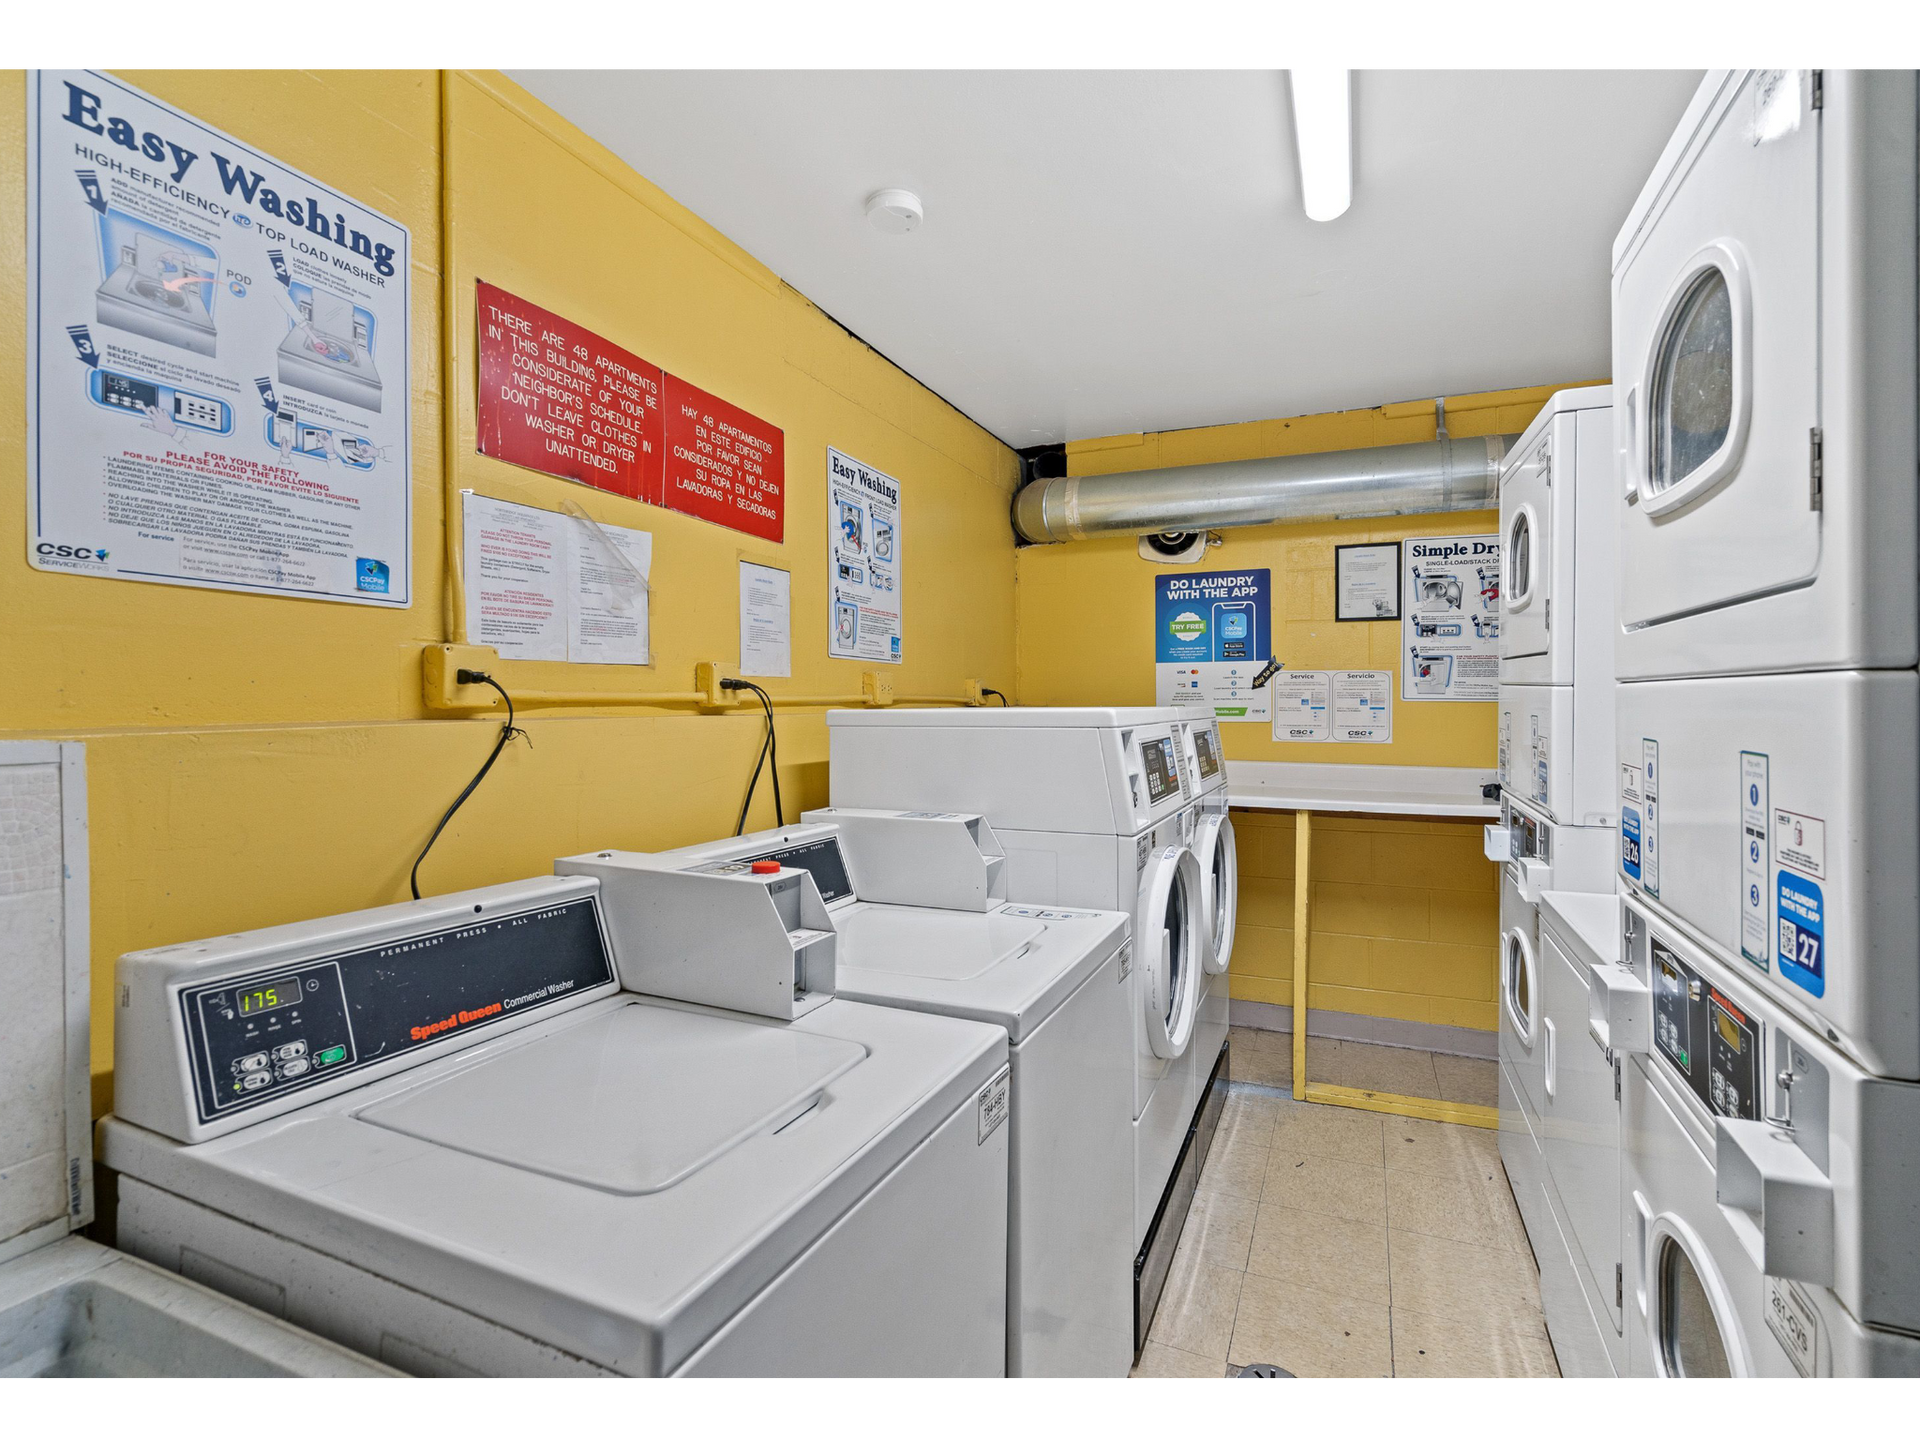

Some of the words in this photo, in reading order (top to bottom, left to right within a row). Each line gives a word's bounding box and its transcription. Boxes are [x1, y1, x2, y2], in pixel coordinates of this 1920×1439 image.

[62, 80, 198, 184] Easy
[211, 151, 395, 277] Washing
[75, 143, 230, 219] HIGH-EFFICIENCY
[86, 184, 98, 199] 1
[256, 222, 286, 242] TOP
[290, 238, 328, 262] LOAD
[332, 256, 385, 288] WASHER
[275, 262, 286, 275] 2
[293, 257, 310, 267] LOAD
[226, 269, 252, 286] POD
[78, 339, 93, 354] 3
[488, 305, 532, 336] THERE
[541, 330, 565, 351] ARE
[573, 345, 588, 361] 48
[595, 355, 657, 394] APARTMENTS
[107, 344, 138, 357] SELECT
[140, 353, 166, 365] desired
[167, 360, 184, 371] cycle
[185, 365, 198, 374] and
[199, 369, 213, 379] start
[214, 373, 240, 387] machine
[488, 324, 501, 341] IN
[510, 332, 539, 356] THIS
[603, 374, 641, 402] PLEASE
[645, 394, 657, 410] BE
[263, 390, 274, 402] 4
[512, 353, 592, 397] CONSIDERATE
[599, 389, 613, 404] OF
[619, 397, 645, 419] YOUR
[513, 371, 583, 410] NEIGHBOR'S
[590, 402, 643, 434] SCHEDULE.
[501, 385, 540, 411] DON'T
[547, 403, 584, 428] LEAVE
[591, 420, 637, 448] CLOTHES
[642, 440, 652, 453] IN
[681, 404, 698, 420] HAY
[703, 415, 714, 427] 48
[718, 422, 773, 454] APARTAMENTOS
[525, 412, 575, 441] WASHER
[581, 433, 596, 449] OR
[603, 441, 635, 463] DRYER
[695, 425, 706, 438] EN
[711, 431, 731, 449] ESTE
[735, 442, 762, 462] EDIFICIO
[107, 462, 150, 475] FLAMMABLE
[152, 471, 189, 483] MATERIALS
[166, 451, 210, 466] PLEASE
[213, 461, 247, 474] AVOID
[251, 468, 271, 479] THE
[274, 474, 329, 491] FOLLOWING
[204, 451, 226, 462] FOR
[230, 457, 258, 469] YOUR
[261, 464, 299, 478] SAFETY
[546, 438, 619, 474] UNATTENDED.
[673, 445, 733, 477] CONSIDERADOS
[737, 469, 743, 480] Y
[746, 474, 756, 486] NO
[759, 479, 779, 495] DEJEN
[696, 440, 713, 455] POR
[716, 448, 740, 466] FAVOR
[744, 460, 762, 475] SEAN
[123, 450, 143, 459] POR
[145, 455, 158, 463] SU
[160, 458, 193, 470] PROPIA
[195, 466, 245, 481] SEGURIDAD,
[246, 476, 263, 485] POR
[264, 479, 289, 489] FAVOR
[291, 484, 312, 494] EVITE
[313, 488, 322, 496] LO
[324, 490, 359, 504] SIGUIENTE
[695, 468, 707, 481] SU
[711, 474, 731, 490] ROPA
[735, 483, 745, 495] EN
[748, 488, 763, 502] LAS
[832, 456, 856, 486] Easy
[858, 468, 897, 504] Washing
[676, 476, 723, 502] LAVADORAS
[727, 494, 733, 504] Y
[737, 497, 776, 520] SECADORAS
[36, 543, 92, 559] CSC
[151, 534, 174, 542] service
[1412, 542, 1468, 559] Simple
[360, 575, 385, 585] CSCPay
[1426, 559, 1491, 567] SINGLE-LOAD/STACK
[360, 583, 385, 591] Mobile
[1167, 589, 1200, 600] WITH
[1203, 588, 1229, 598] THE
[1231, 586, 1258, 597] APP
[1170, 580, 1189, 590] DO
[1192, 575, 1254, 589] LAUNDRY
[1630, 843, 1639, 864] 26
[1780, 897, 1796, 912] WITH
[1796, 902, 1807, 917] THE
[1807, 908, 1820, 923] APP
[1782, 886, 1790, 898] DO
[1791, 889, 1818, 910] LAUNDRY
[380, 937, 444, 957] PERMANENT
[456, 927, 487, 939] PRESS
[512, 918, 528, 926] ALL
[538, 908, 567, 920] FABRIC
[1798, 933, 1819, 968] 27
[244, 989, 278, 1012] 175
[410, 1015, 458, 1041] Speed
[458, 1002, 502, 1025] Queen
[504, 987, 547, 1009] Commercial
[548, 979, 574, 995] Washer
[1772, 1290, 1808, 1352] 281-CVS
